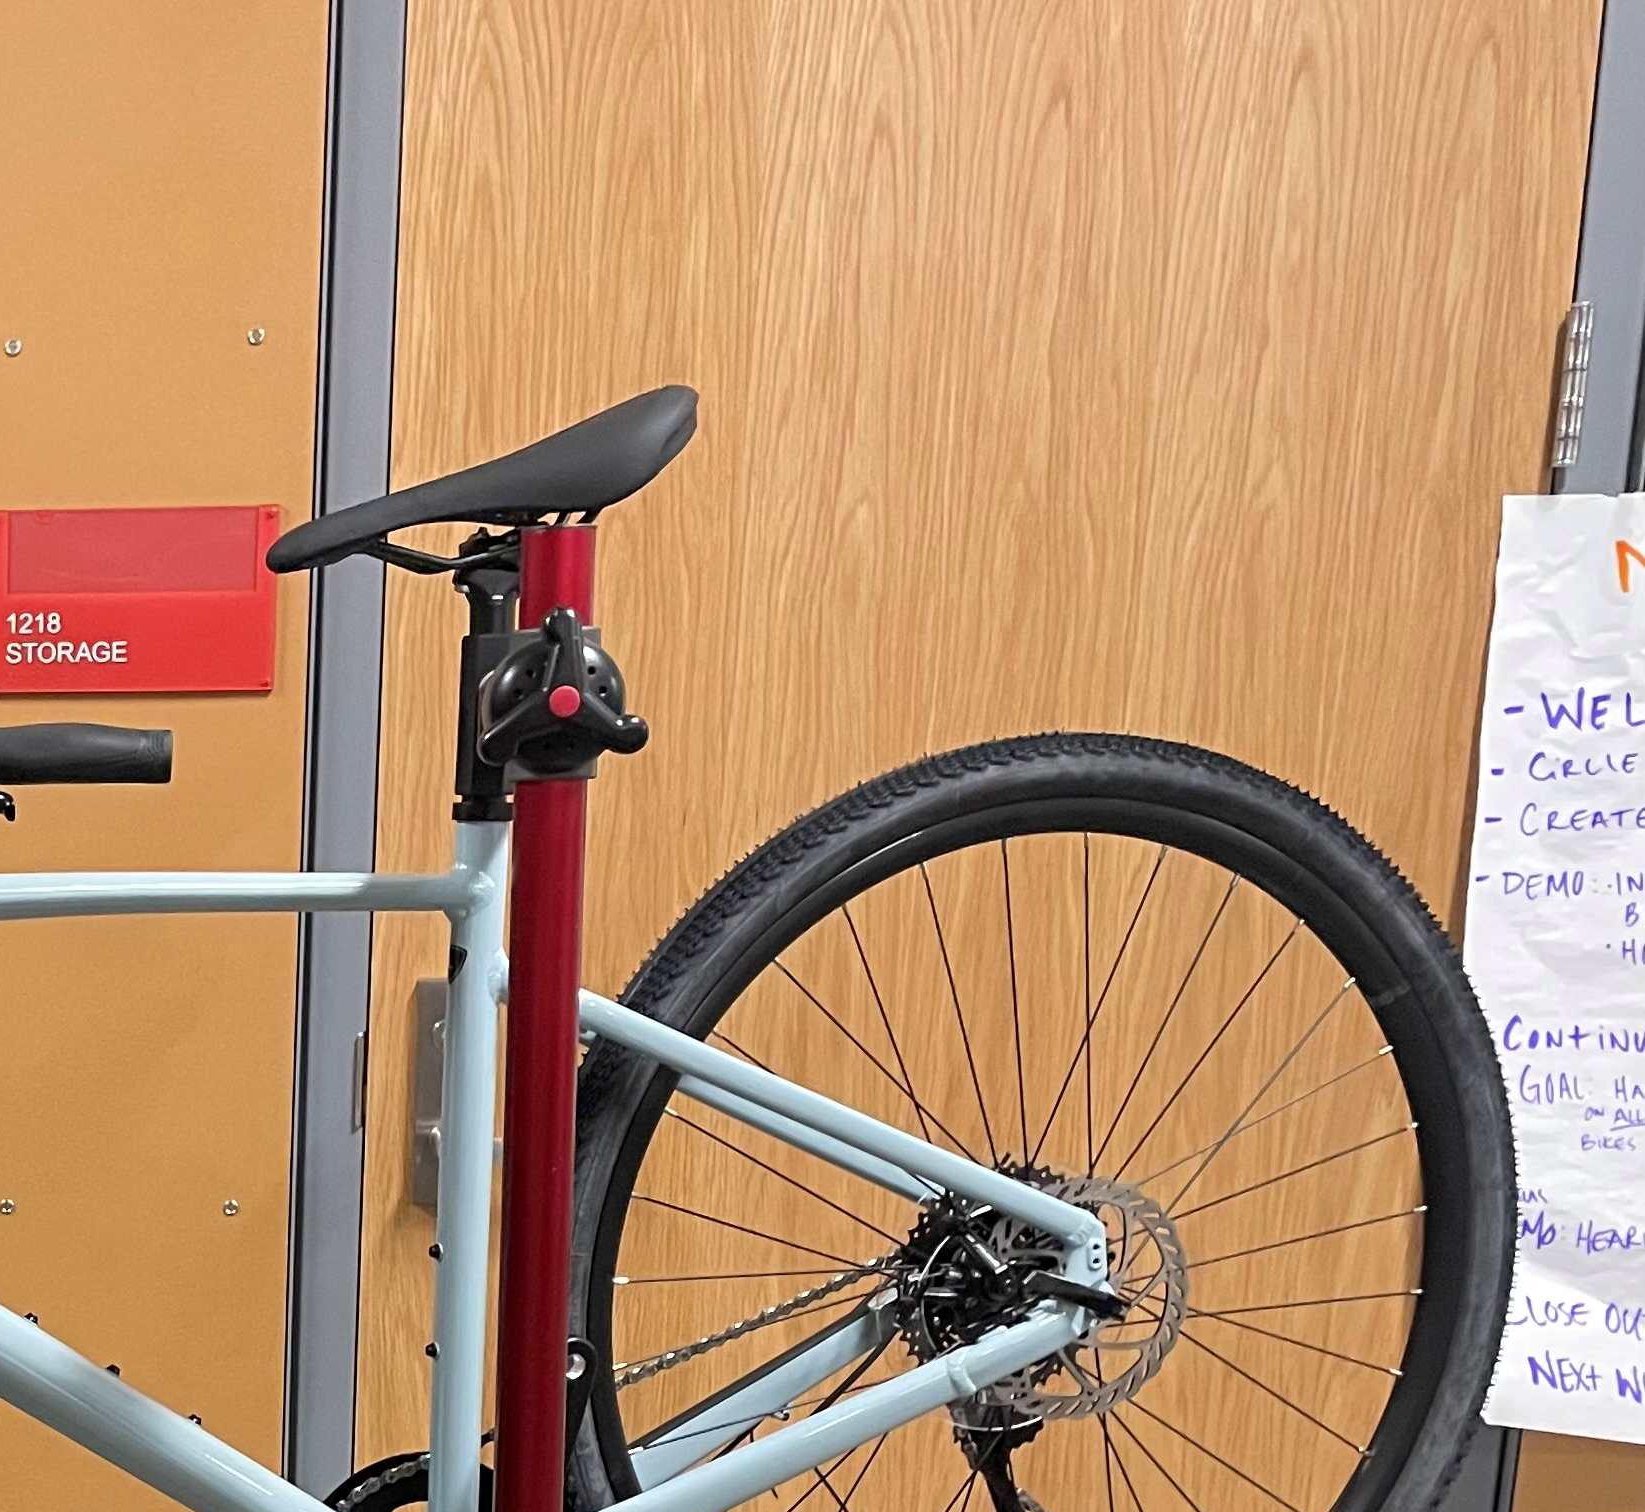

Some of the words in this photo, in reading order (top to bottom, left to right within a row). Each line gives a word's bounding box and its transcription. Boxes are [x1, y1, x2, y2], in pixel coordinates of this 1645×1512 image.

[5, 612, 62, 635] 1218
[5, 640, 129, 665] STORAGE
[1622, 938, 1645, 966] H
